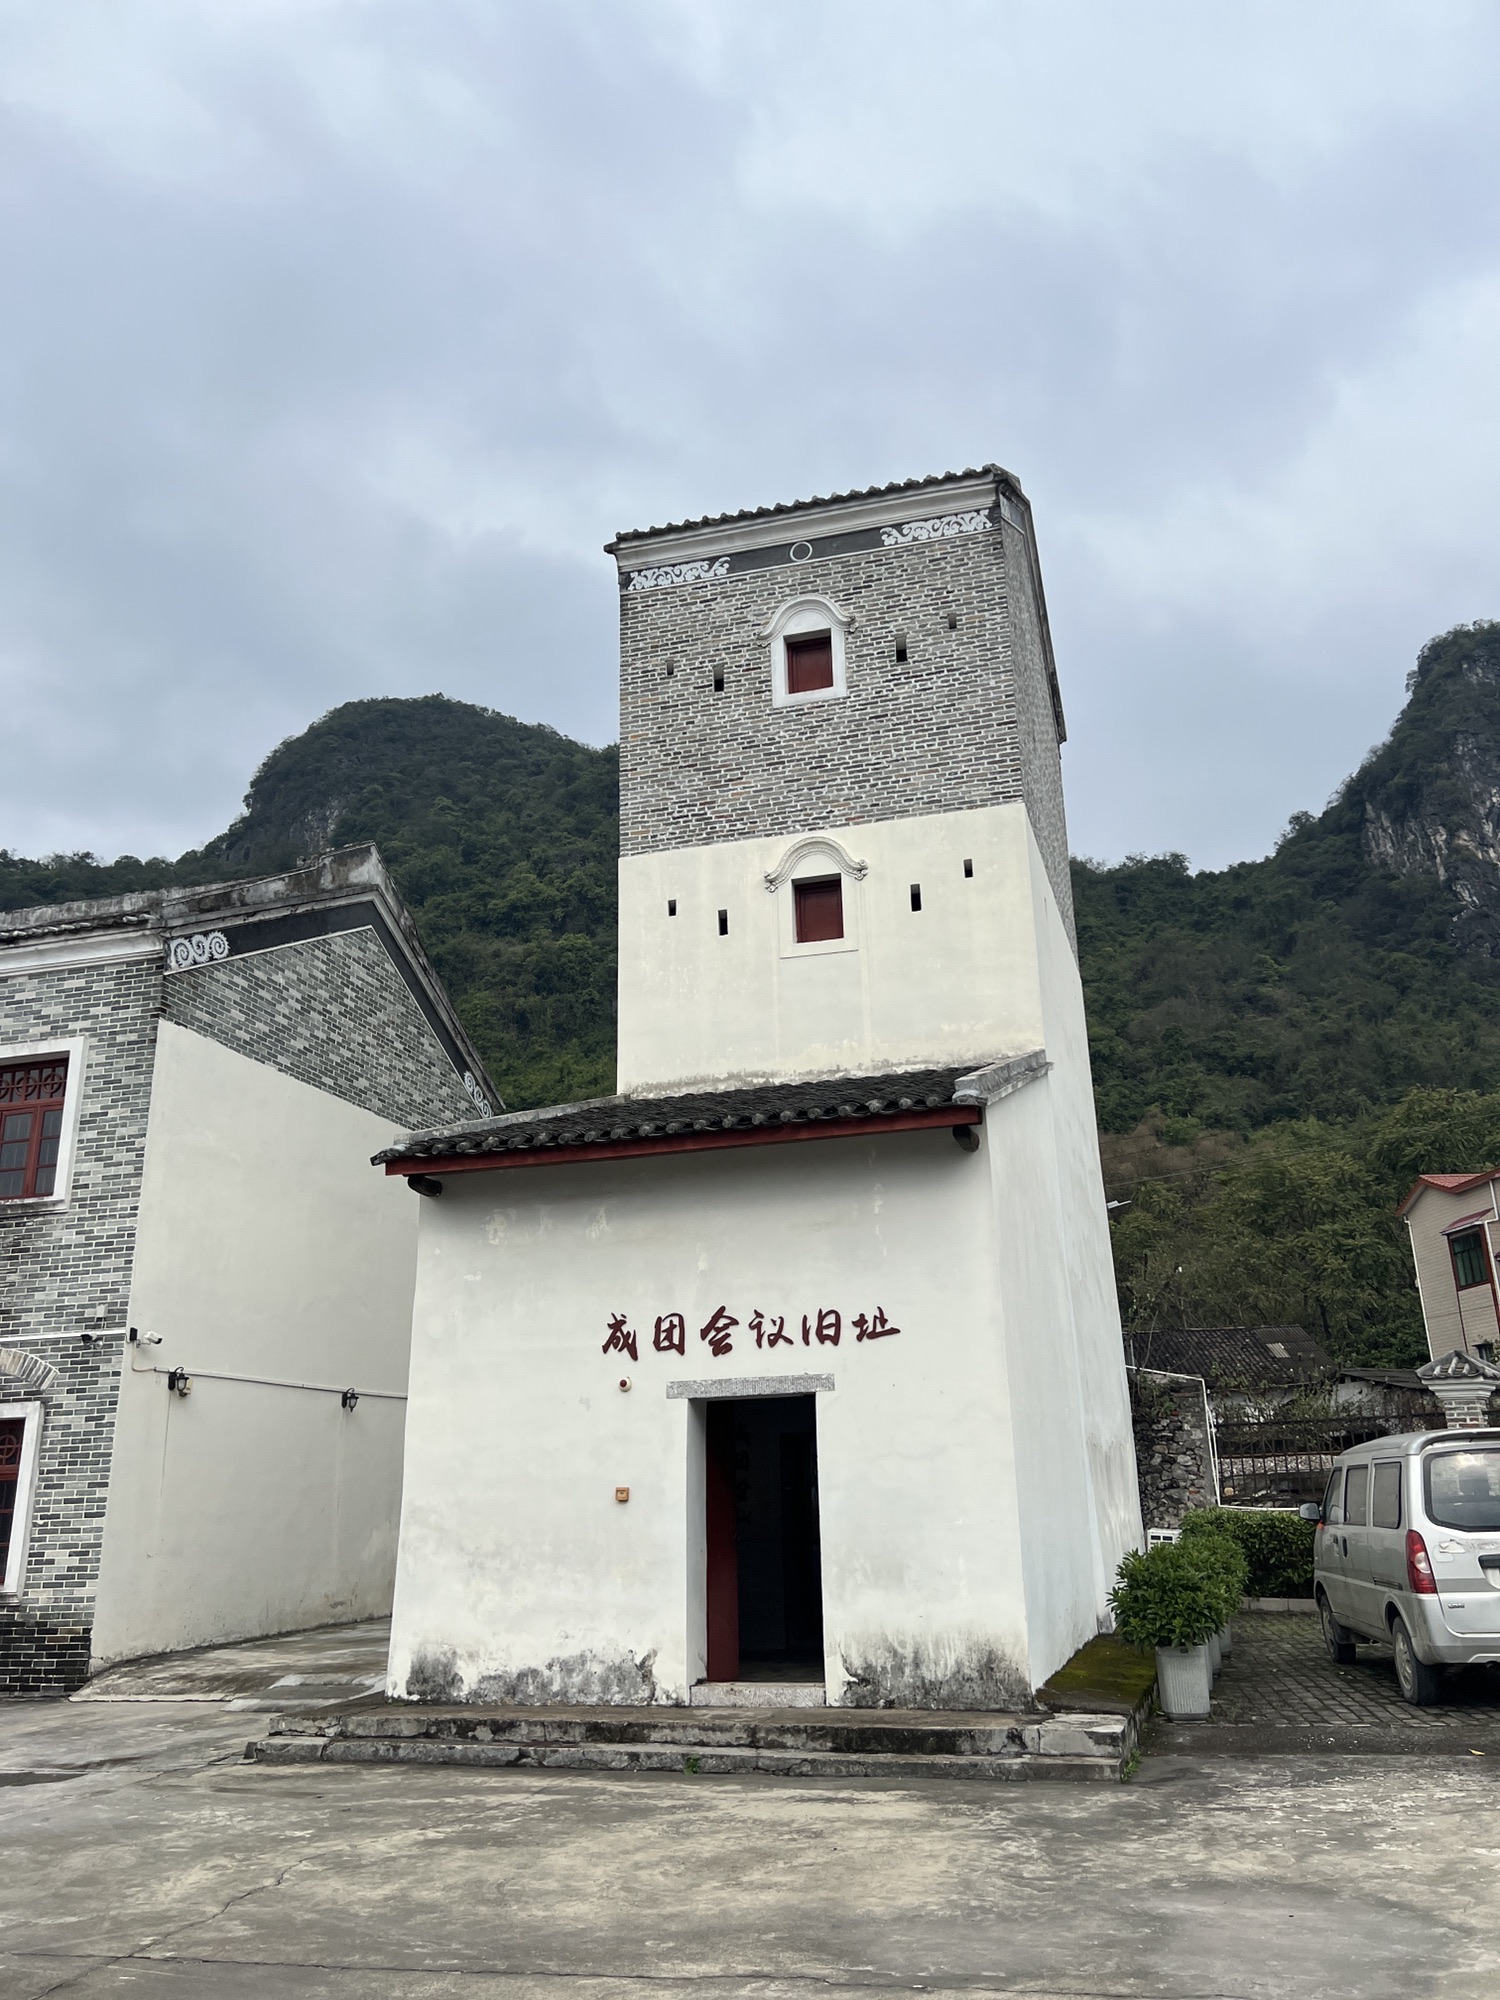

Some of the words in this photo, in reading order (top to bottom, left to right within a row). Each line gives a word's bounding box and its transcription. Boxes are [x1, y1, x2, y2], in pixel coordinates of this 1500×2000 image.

[602, 1305, 901, 1361] 成团会议旧址
